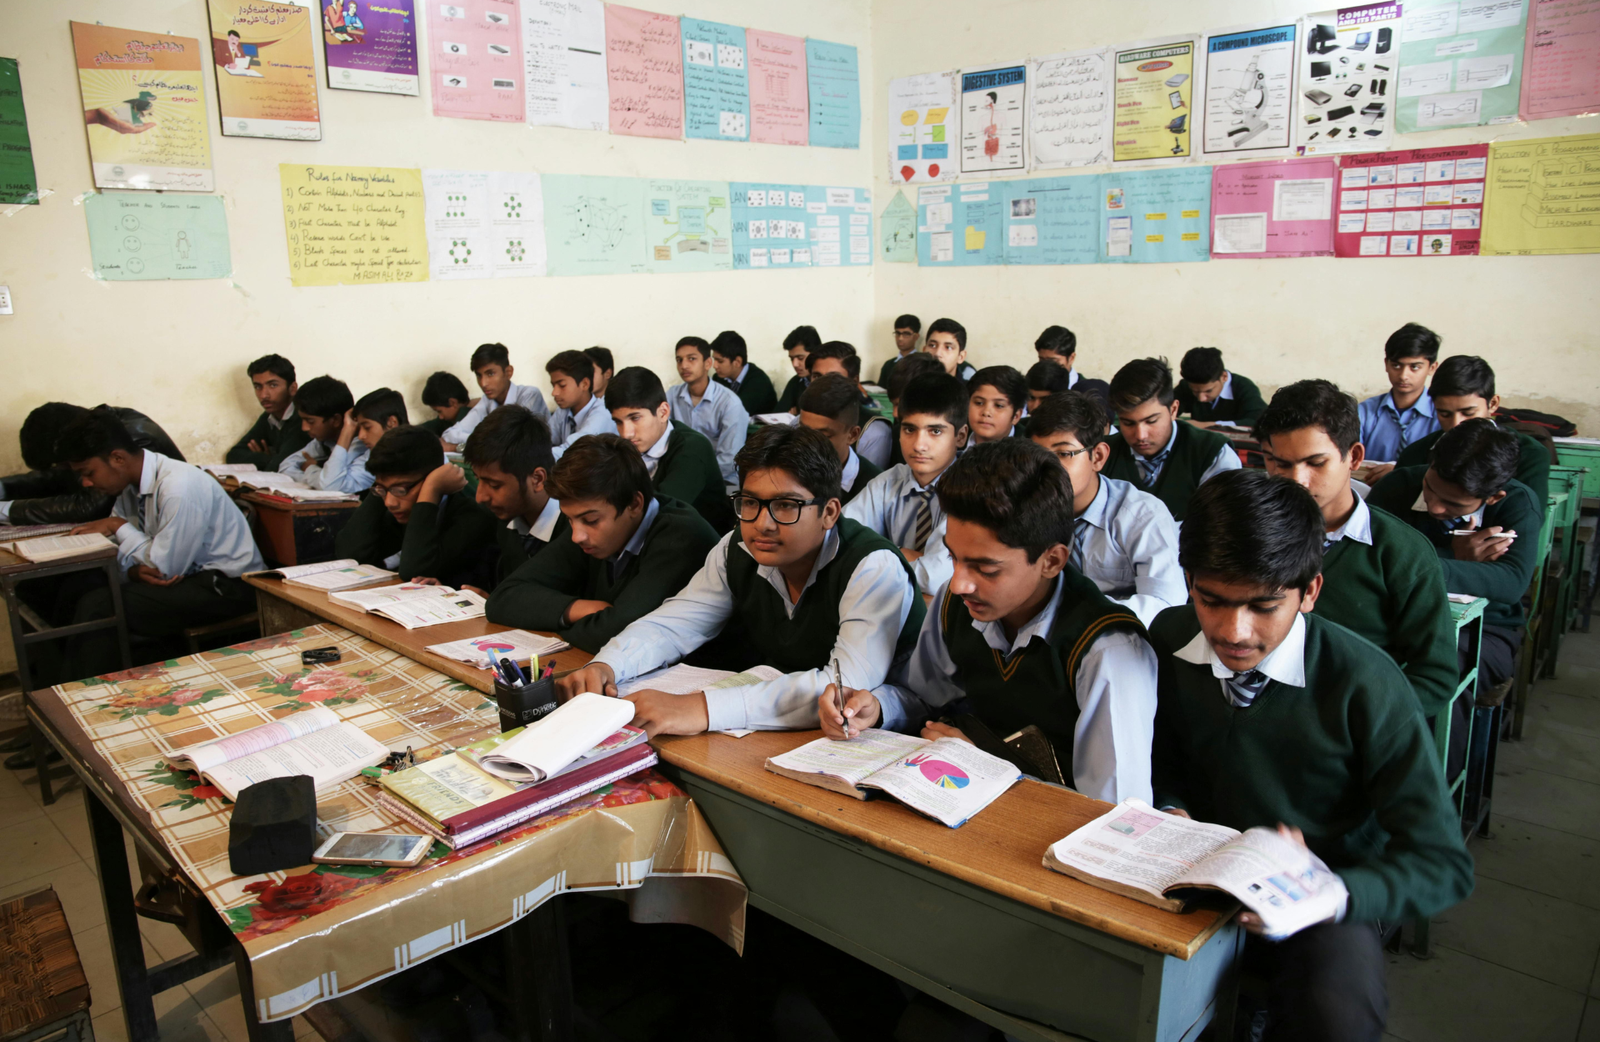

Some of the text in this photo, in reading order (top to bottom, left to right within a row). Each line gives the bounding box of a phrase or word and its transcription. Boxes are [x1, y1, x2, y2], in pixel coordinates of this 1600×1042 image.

[1338, 5, 1397, 20] COMPUTER
[1338, 12, 1397, 26] AND ITS PARTS
[1217, 36, 1249, 51] COMPOUND
[1250, 31, 1288, 45] MICROSCOPE
[1119, 46, 1189, 63] HARDWARE COMPUTERS
[963, 70, 1023, 91] DIGESTIVE SYSTEM
[730, 191, 746, 204] LAN
[1547, 219, 1592, 227] HARDWARE
[427, 781, 465, 805] FRIENDS
